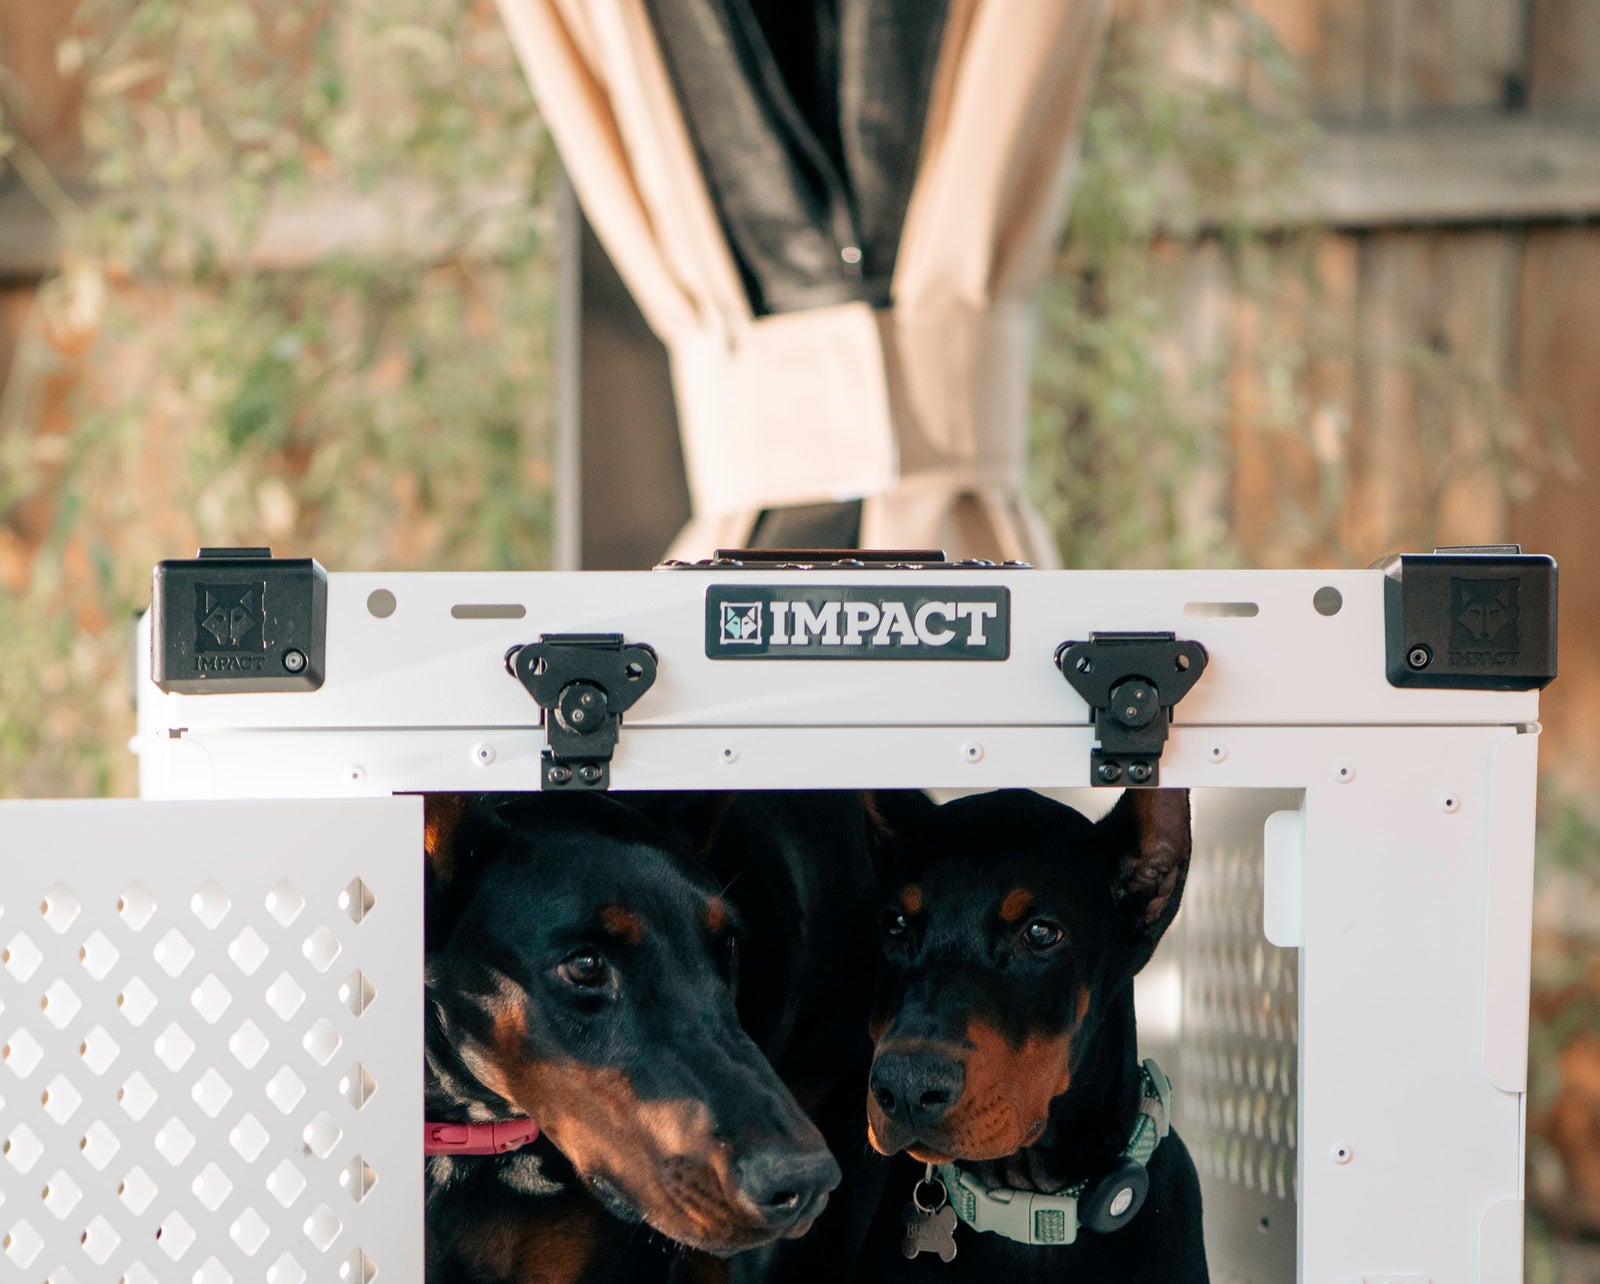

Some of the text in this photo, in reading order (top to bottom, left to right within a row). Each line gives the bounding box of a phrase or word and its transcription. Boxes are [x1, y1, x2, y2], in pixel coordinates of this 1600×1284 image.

[769, 602, 997, 646] IMPACT
[194, 656, 266, 671] IMPACT
[1449, 651, 1520, 666] IMPACT
